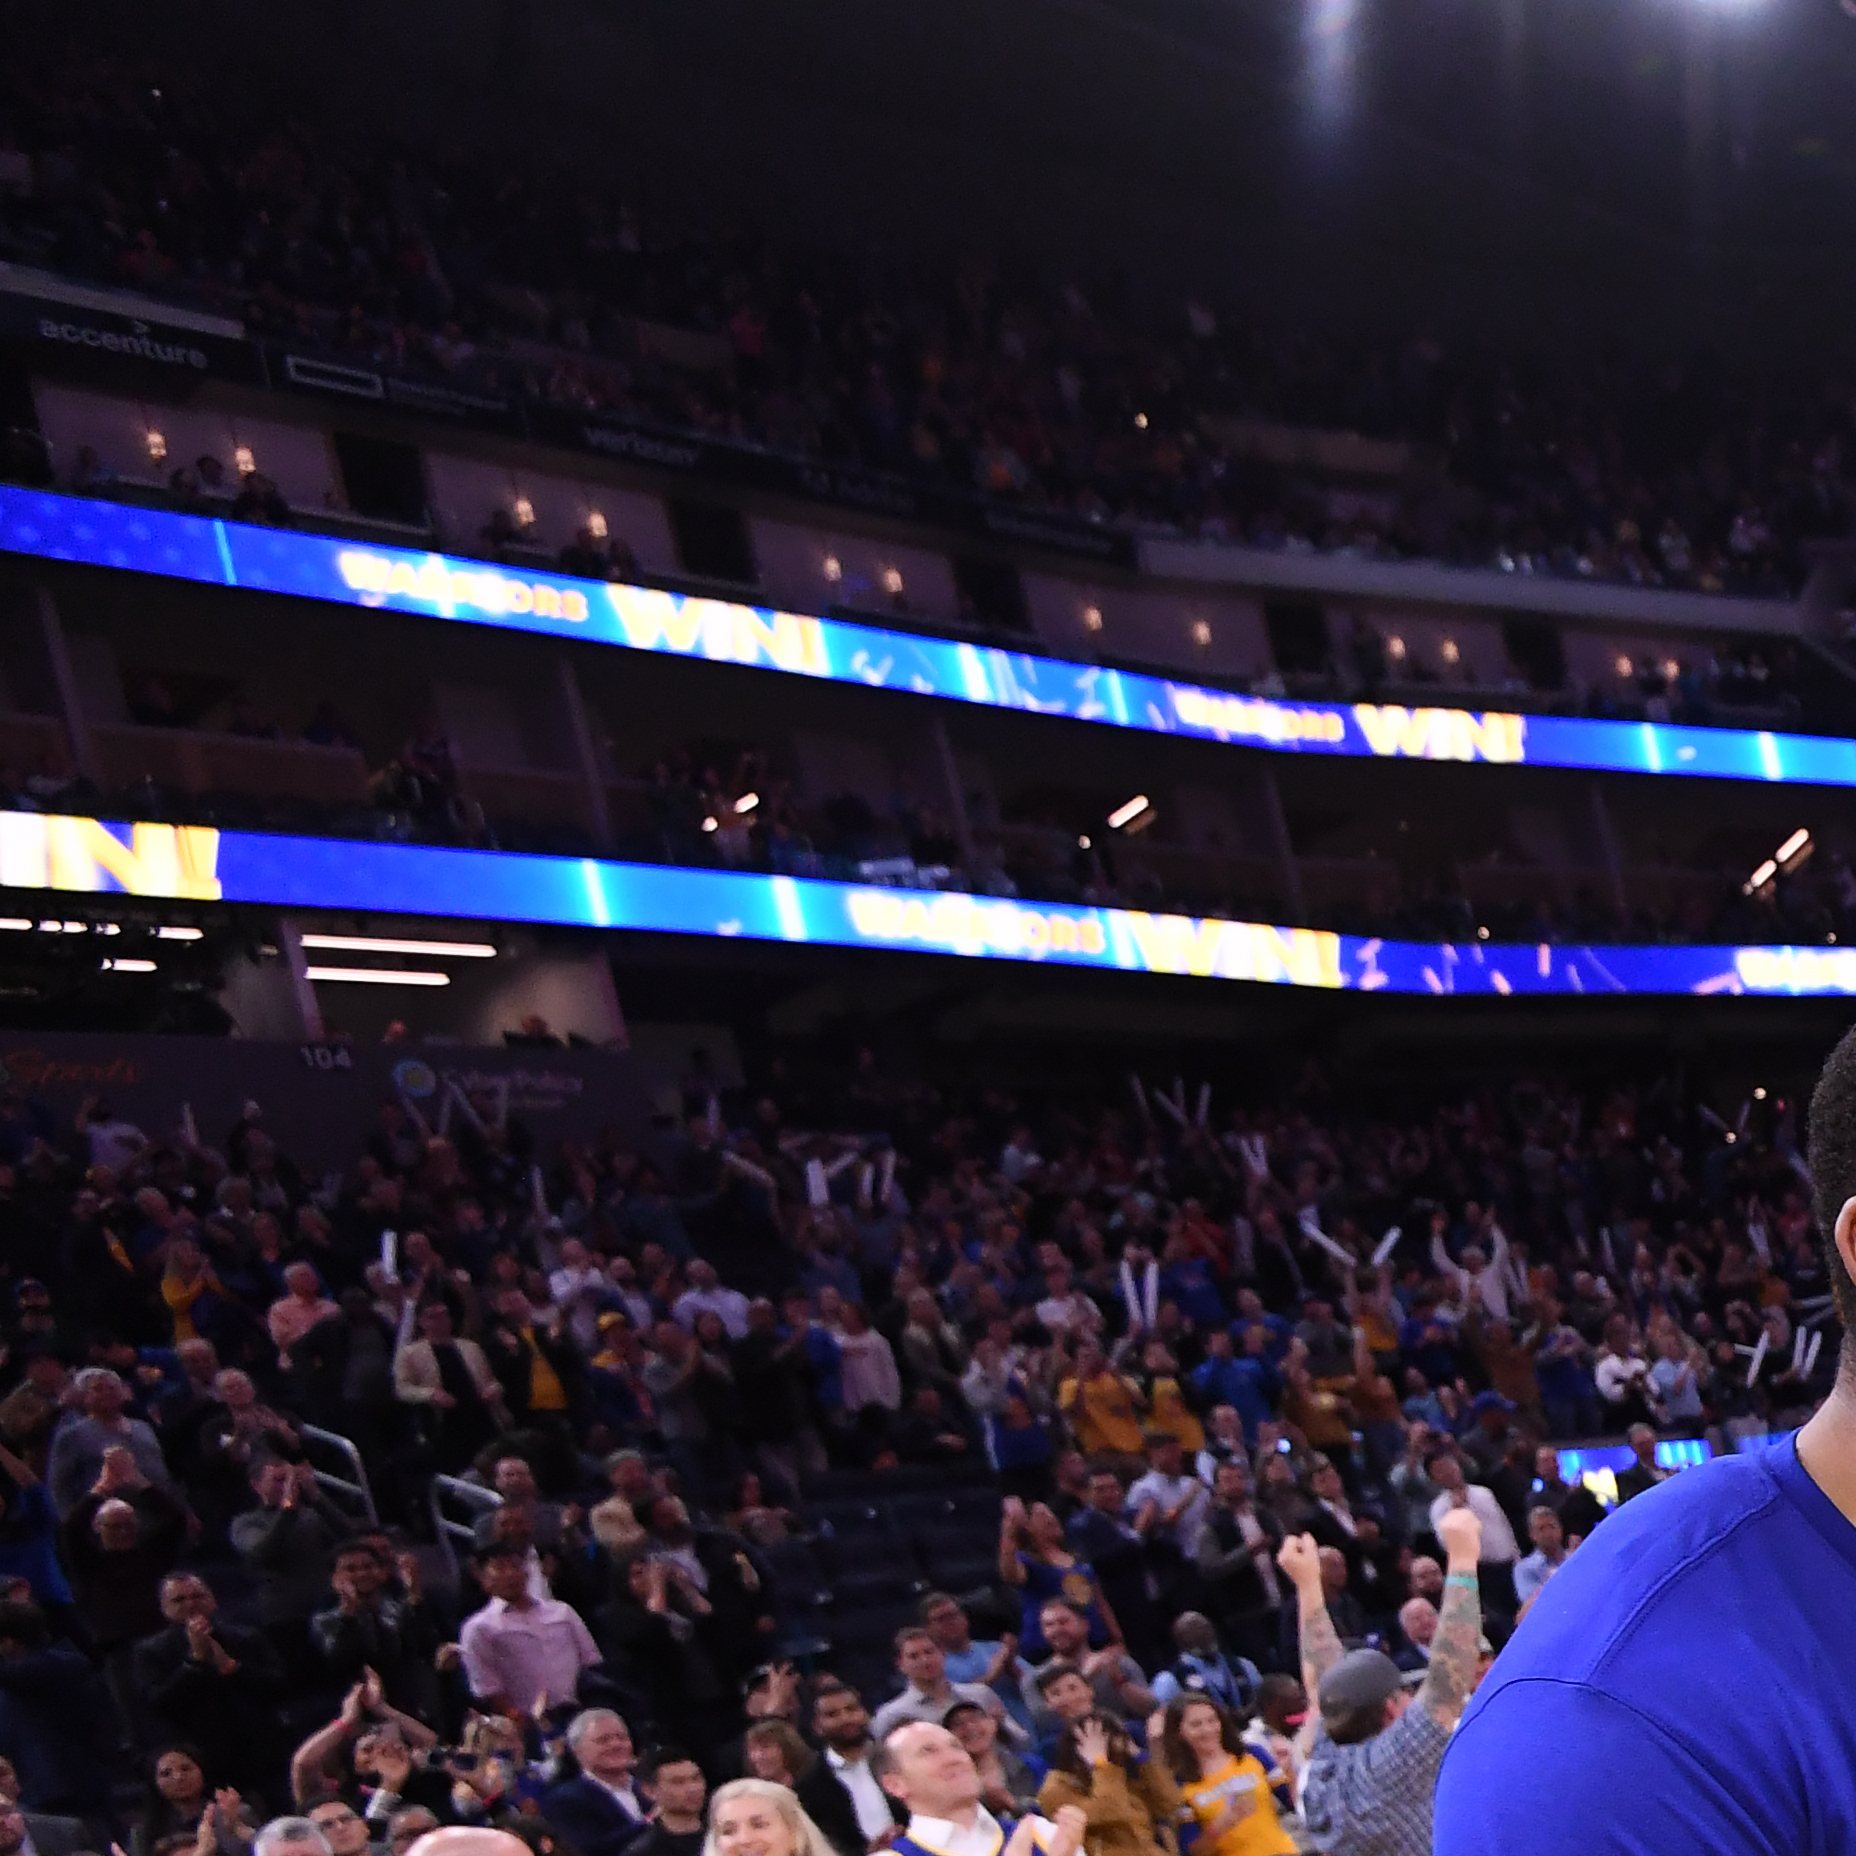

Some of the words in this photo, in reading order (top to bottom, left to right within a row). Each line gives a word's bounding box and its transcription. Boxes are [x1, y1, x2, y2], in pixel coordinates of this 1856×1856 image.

[39, 317, 208, 370] accenture
[340, 550, 587, 621] WARRIORS
[606, 584, 828, 675] WIN!
[1354, 704, 1524, 762] WIN!
[1122, 910, 1340, 987] WIN!
[300, 1046, 352, 1070] 104
